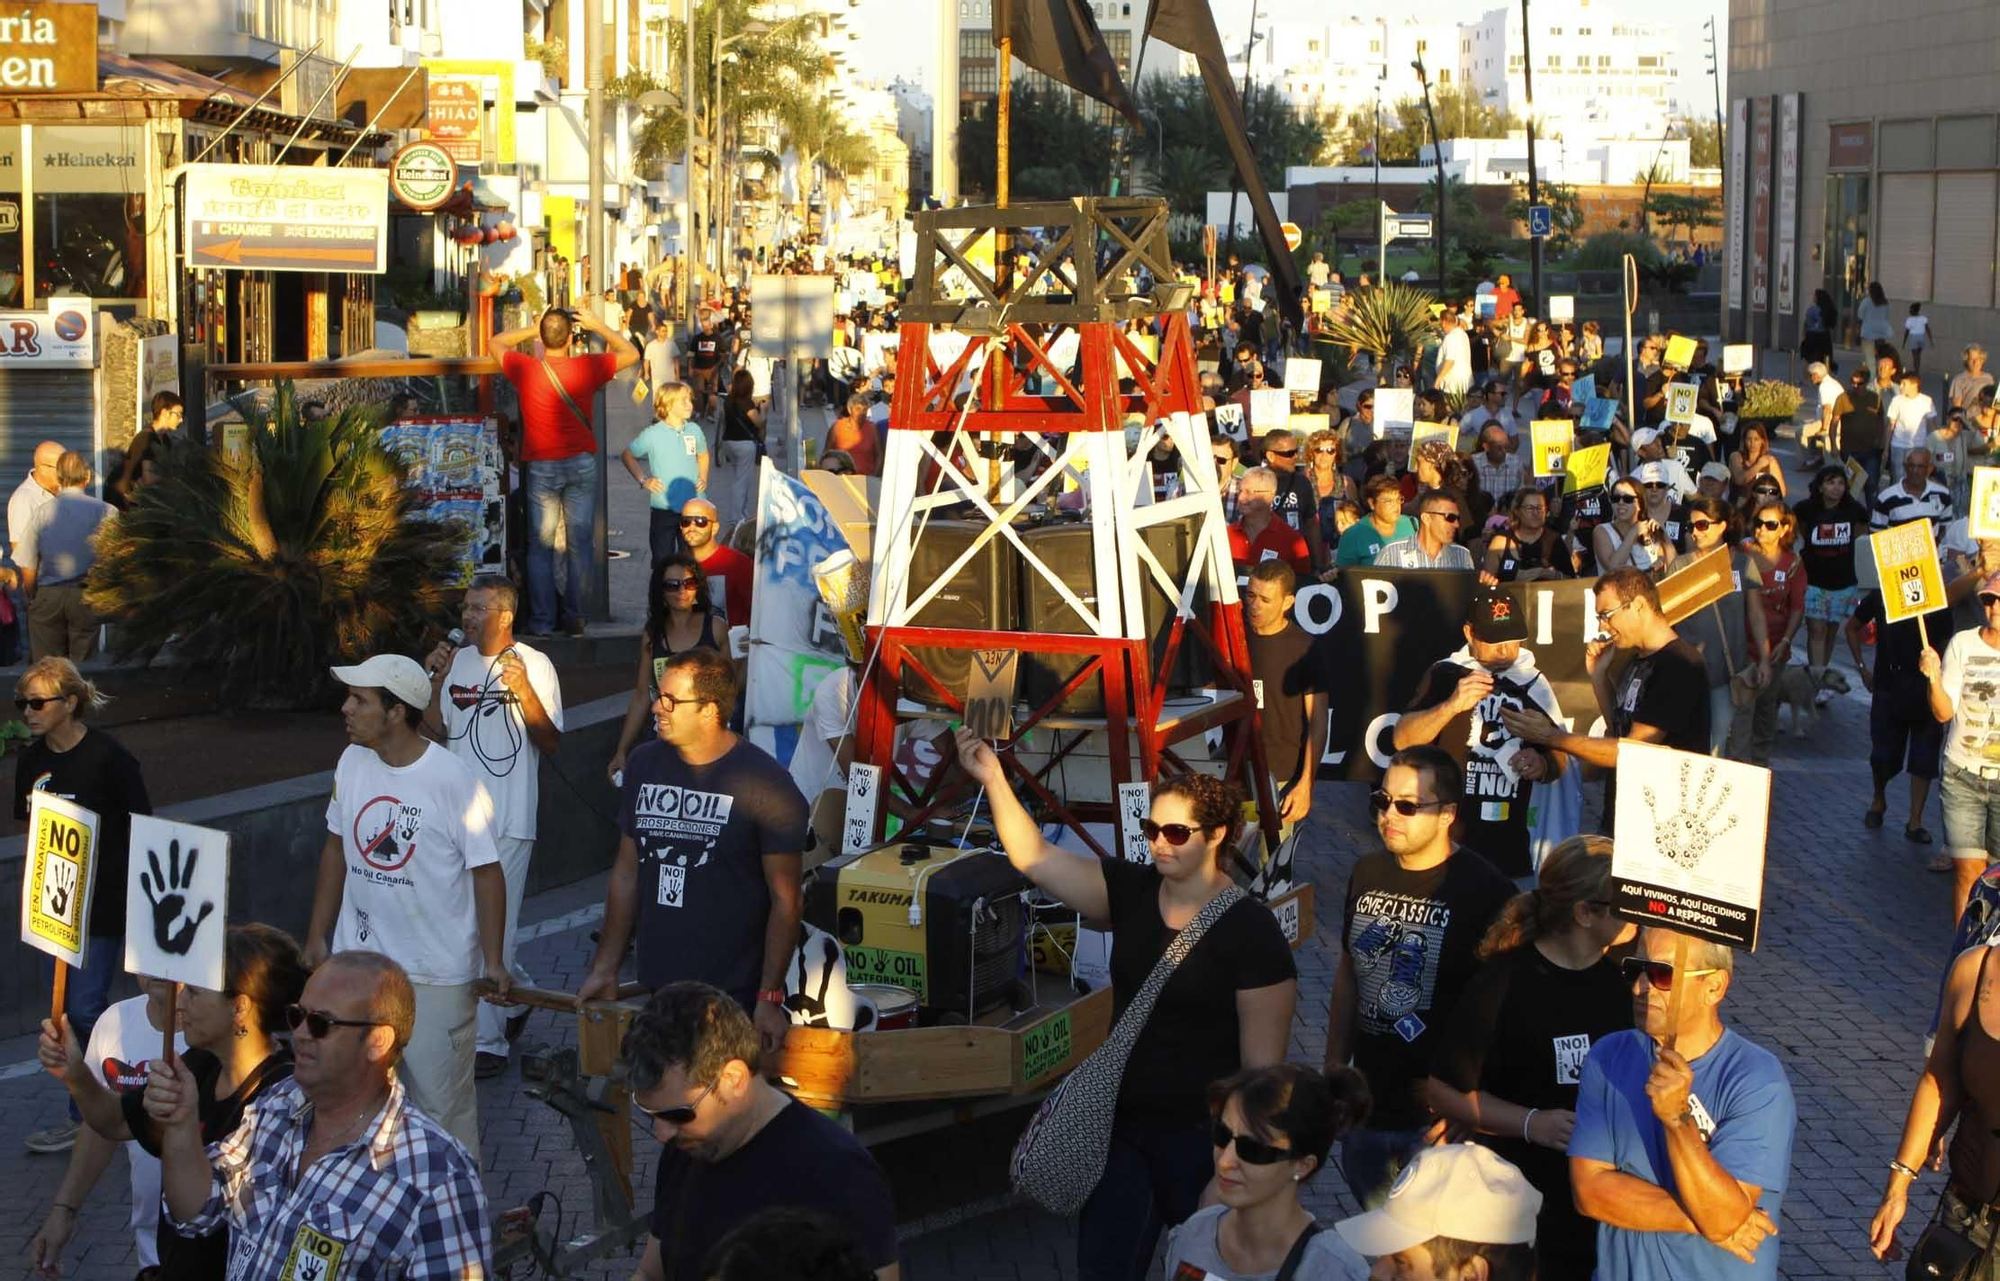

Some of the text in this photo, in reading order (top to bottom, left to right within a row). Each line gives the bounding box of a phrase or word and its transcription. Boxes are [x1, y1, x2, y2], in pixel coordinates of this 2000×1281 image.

[1, 9, 57, 43] ría
[0, 57, 57, 87] en
[57, 152, 136, 167] Heineken
[400, 169, 447, 181] Heineken
[219, 222, 375, 240] CHANGE EXCHANGE
[1676, 388, 1691, 398] NO
[1548, 446, 1561, 454] NO
[1900, 565, 1919, 580] NO
[1294, 579, 1398, 635] OP
[856, 767, 872, 778] NO!
[1467, 761, 1501, 773] CANA
[1128, 788, 1144, 798] NO!
[1465, 772, 1518, 798] DICE NO!
[402, 805, 422, 818] NO!
[851, 818, 867, 829] NO!
[50, 820, 80, 858] NO
[1131, 833, 1145, 842] NO
[32, 818, 48, 914] EN CANARIAS
[664, 866, 684, 879] NO!
[73, 834, 90, 932] PROSPECCIONES
[351, 865, 363, 876] No
[363, 868, 374, 880] Oil
[376, 872, 414, 888] Canarias
[849, 889, 914, 907] TAKUMA
[1621, 883, 1747, 922] AQUÍ VIVIMOS, AQUÍ DECIDIMOS
[1648, 901, 1666, 914] NO
[1667, 907, 1675, 916] A
[845, 950, 922, 977] NO OIL
[1025, 1017, 1069, 1059] NO OIL
[1561, 1037, 1587, 1050] NO!
[240, 1239, 256, 1259] NO!
[305, 1231, 332, 1257] NO
